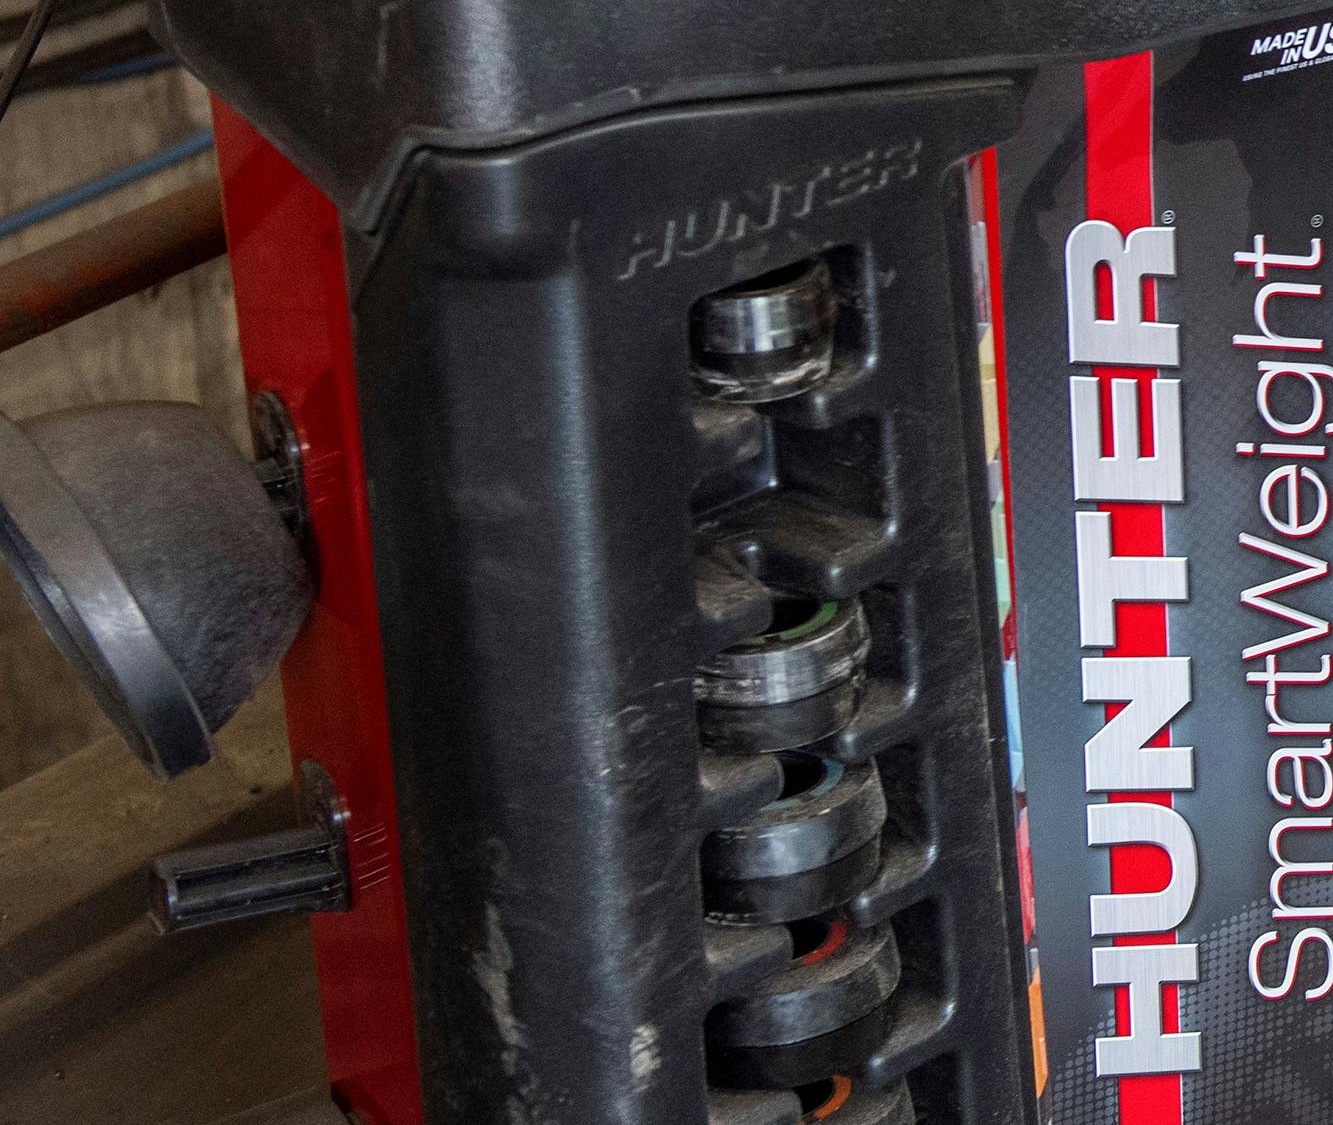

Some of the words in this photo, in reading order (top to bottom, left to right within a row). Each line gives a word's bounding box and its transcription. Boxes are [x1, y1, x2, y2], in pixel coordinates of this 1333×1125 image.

[1250, 28, 1307, 56] MADE
[1280, 46, 1303, 65] IN
[616, 138, 924, 282] HUNTER
